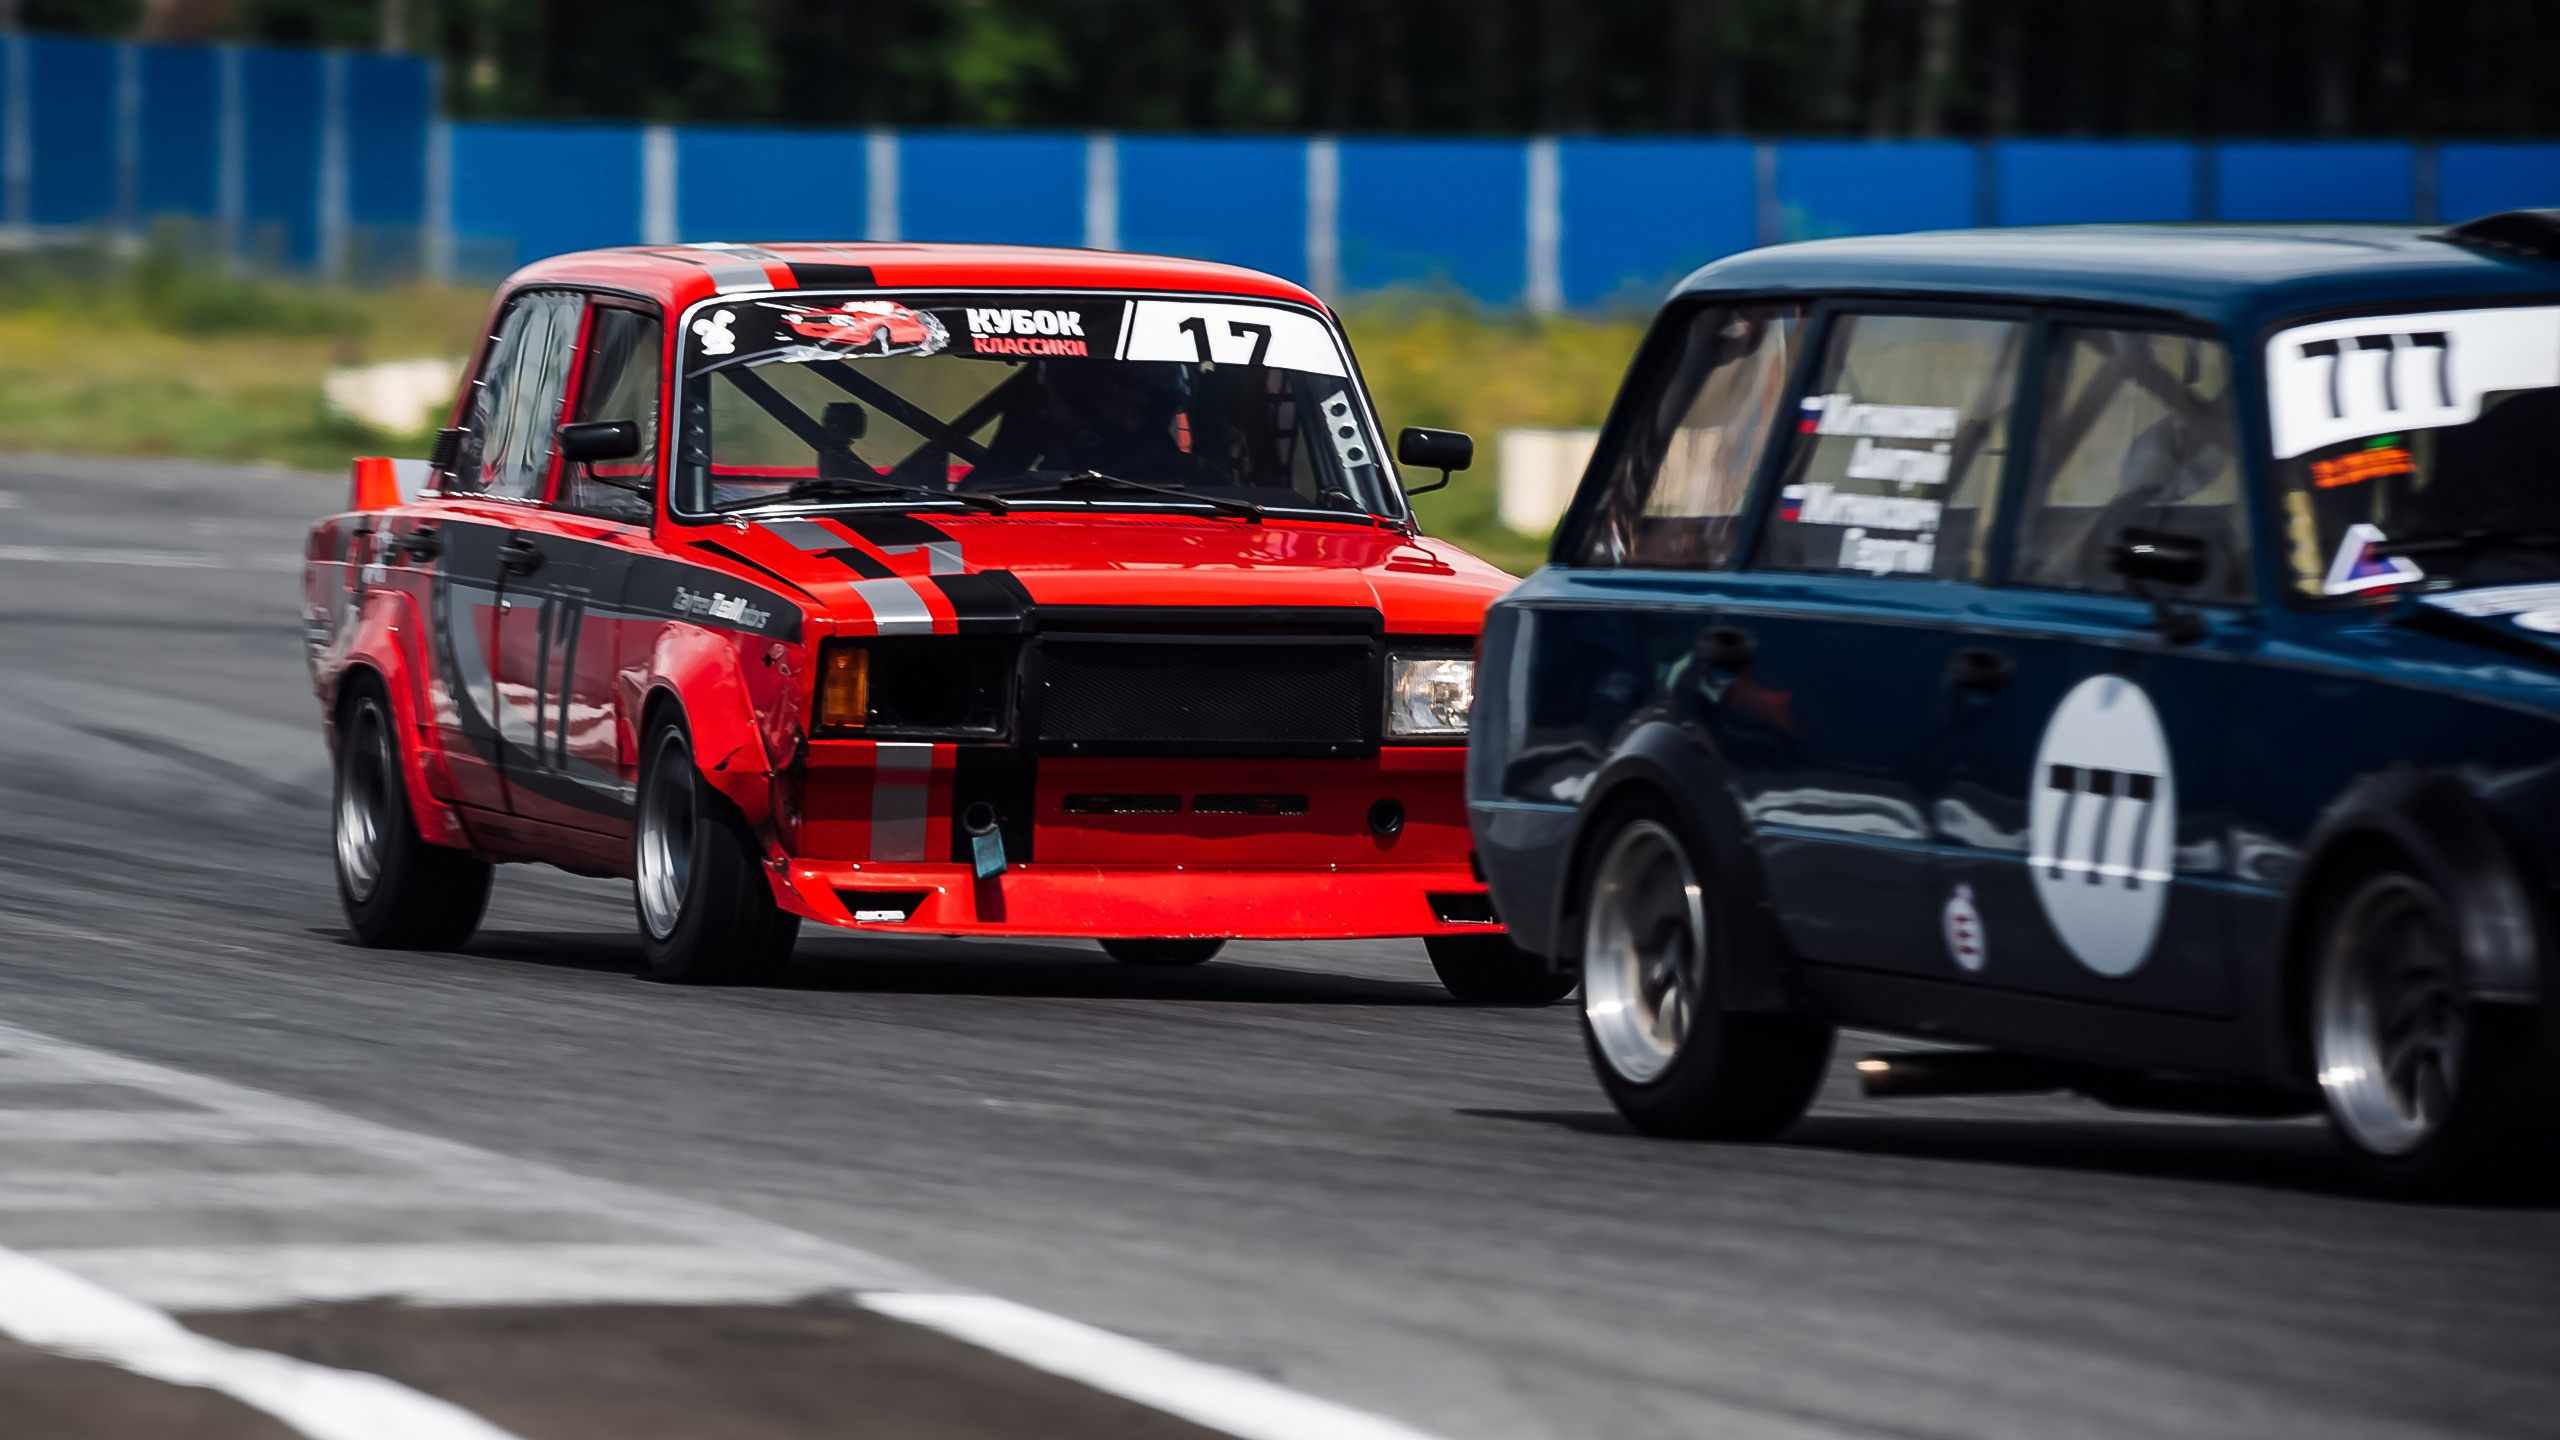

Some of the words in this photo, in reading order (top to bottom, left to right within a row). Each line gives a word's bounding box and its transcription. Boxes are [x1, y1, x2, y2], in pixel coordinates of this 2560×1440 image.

[965, 308, 1085, 336] КУБОК
[973, 337, 1089, 357] КЛАССИКИ
[1178, 311, 1273, 367] 17
[2298, 331, 2455, 418] 777
[2047, 764, 2162, 890] 777
